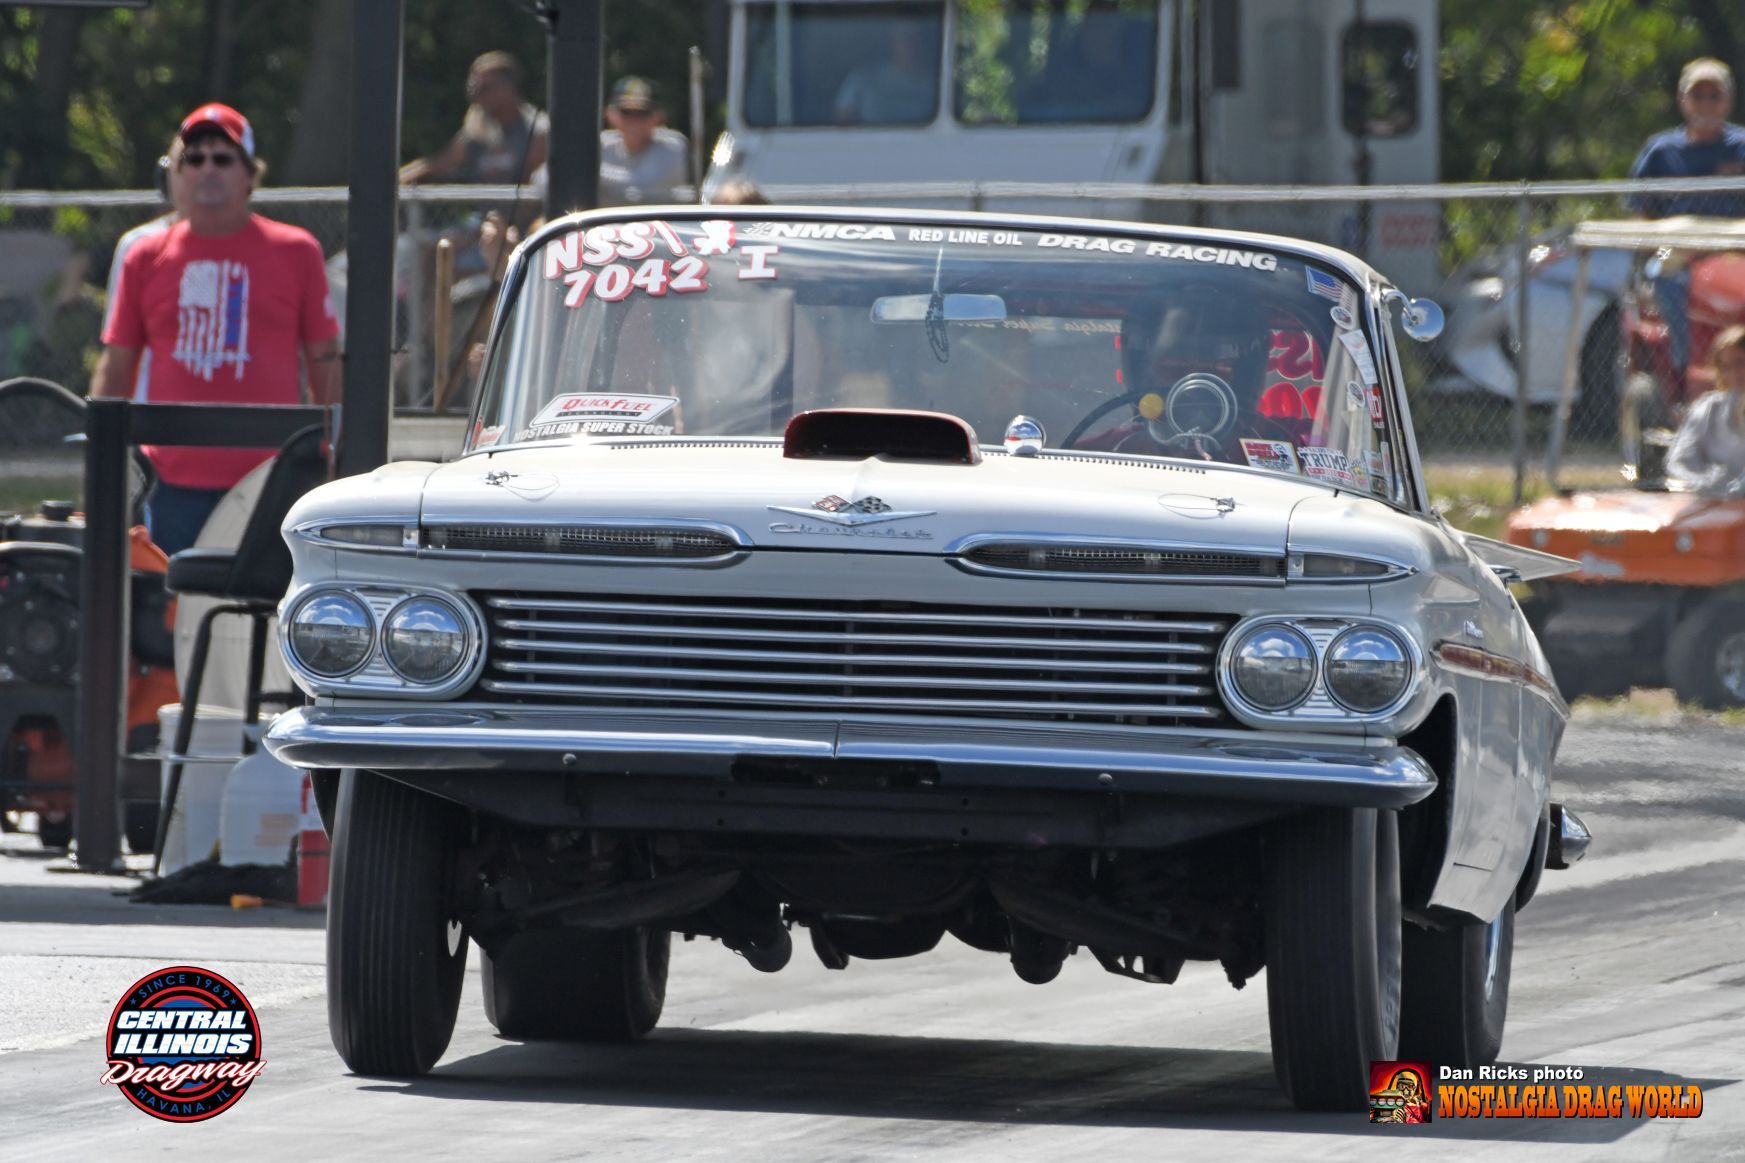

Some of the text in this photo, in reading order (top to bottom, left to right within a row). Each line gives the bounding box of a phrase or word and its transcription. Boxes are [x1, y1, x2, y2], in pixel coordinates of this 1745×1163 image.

[769, 223, 1277, 272] NMCA RED LINE OIL DRAG RACING
[563, 255, 711, 309] 7042
[513, 422, 579, 443] NOSTALGIA
[581, 421, 625, 434] SUPER
[627, 423, 675, 436] STOCK
[1300, 452, 1348, 472] TRUMP
